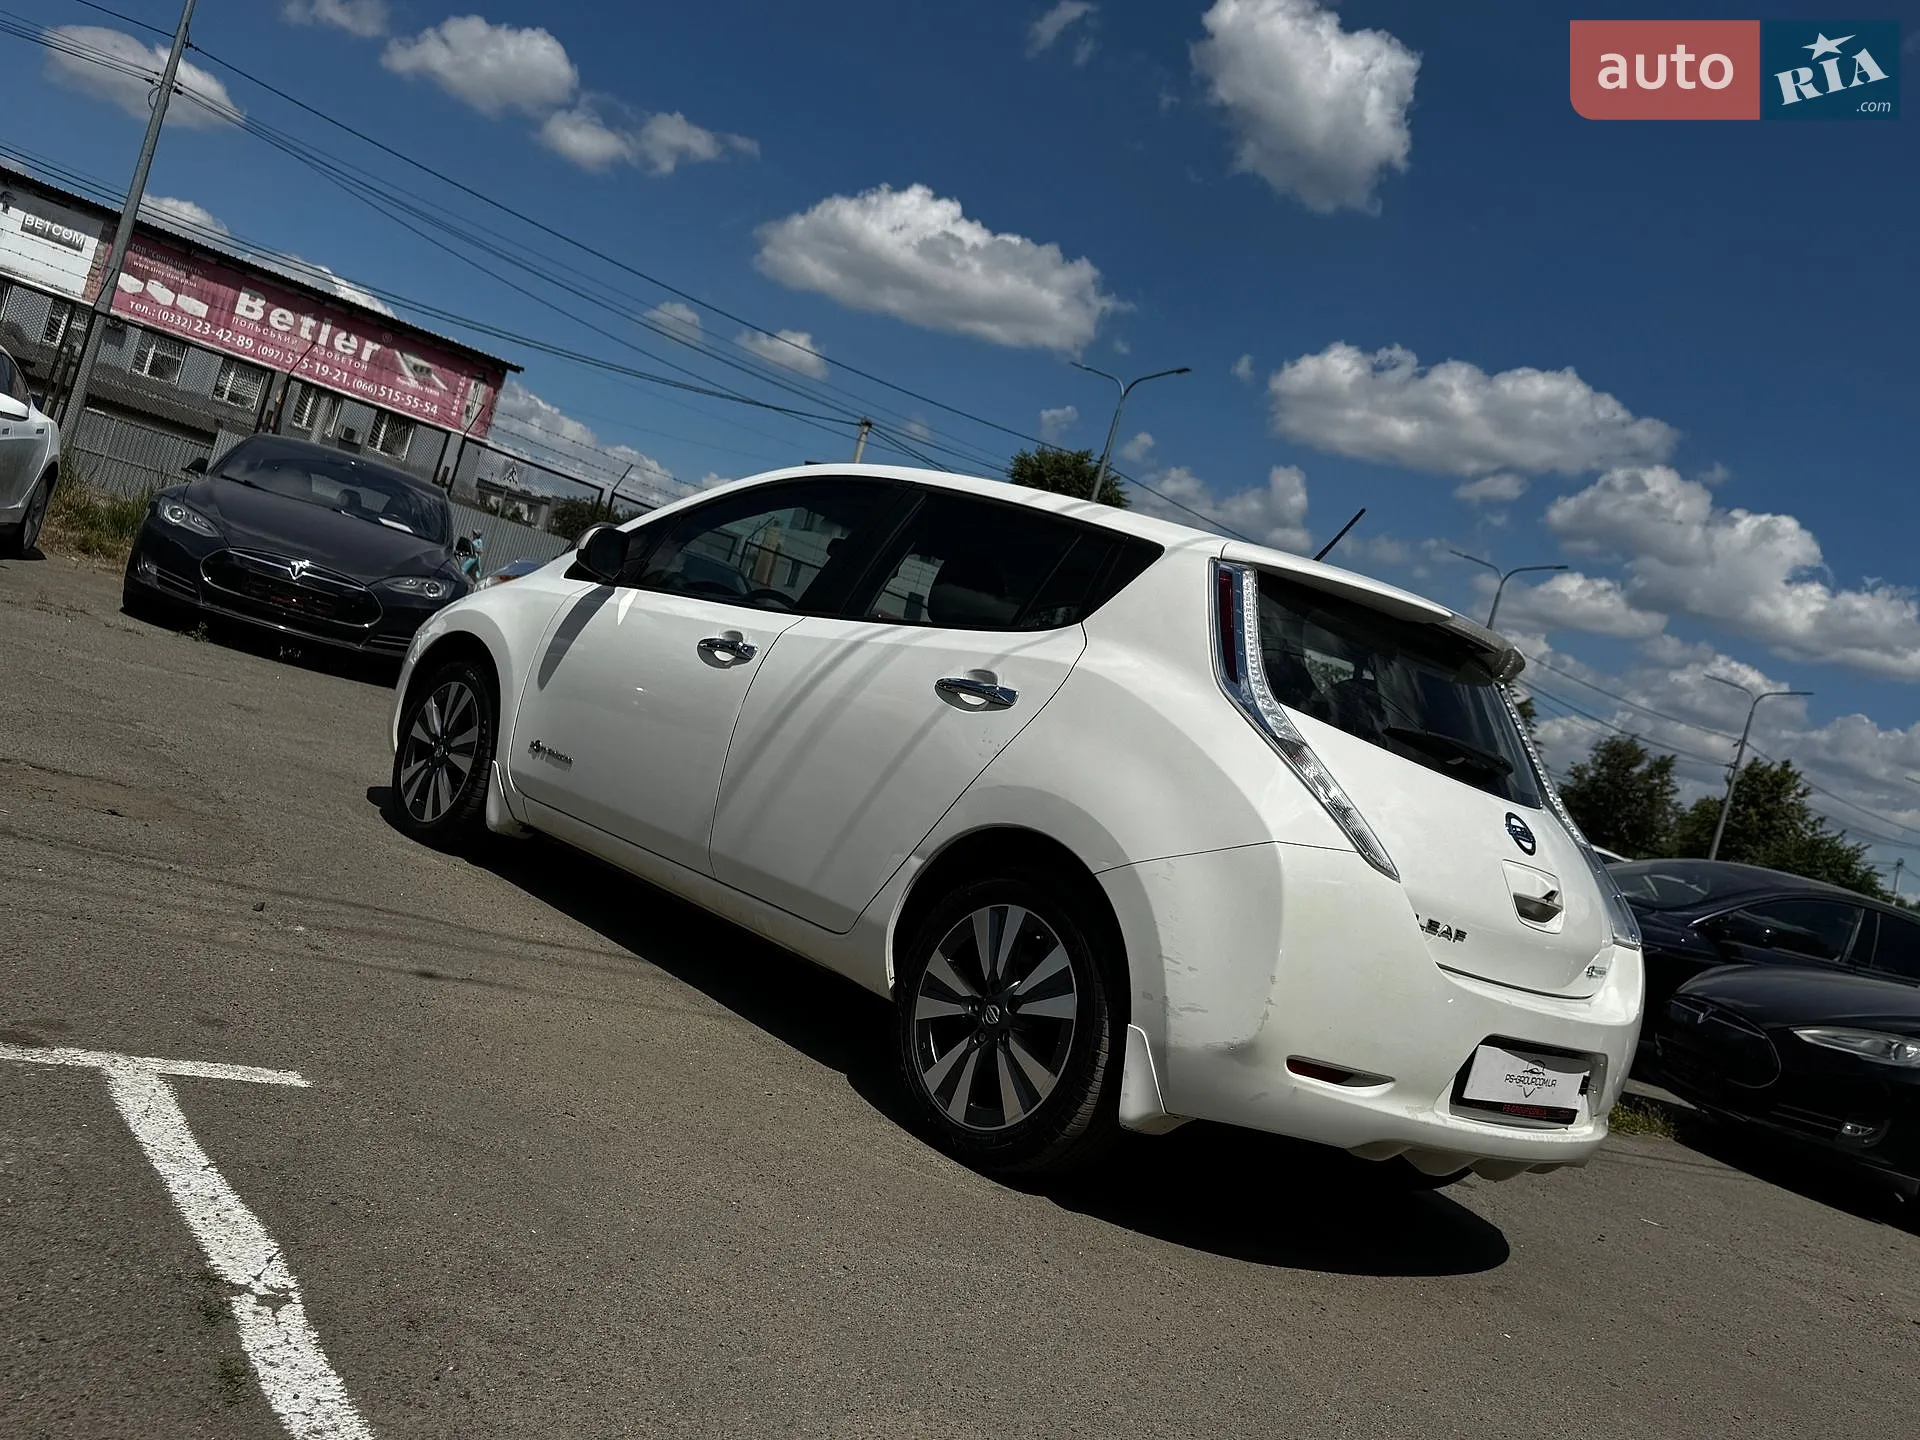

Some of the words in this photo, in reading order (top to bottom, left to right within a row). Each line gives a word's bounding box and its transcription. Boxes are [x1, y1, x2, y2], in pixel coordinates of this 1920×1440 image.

[24, 213, 86, 246] BETCOM
[157, 309, 193, 330] (0332)
[257, 344, 284, 363] (097)
[352, 377, 378, 396] (066)
[378, 384, 439, 416] 515-55-54
